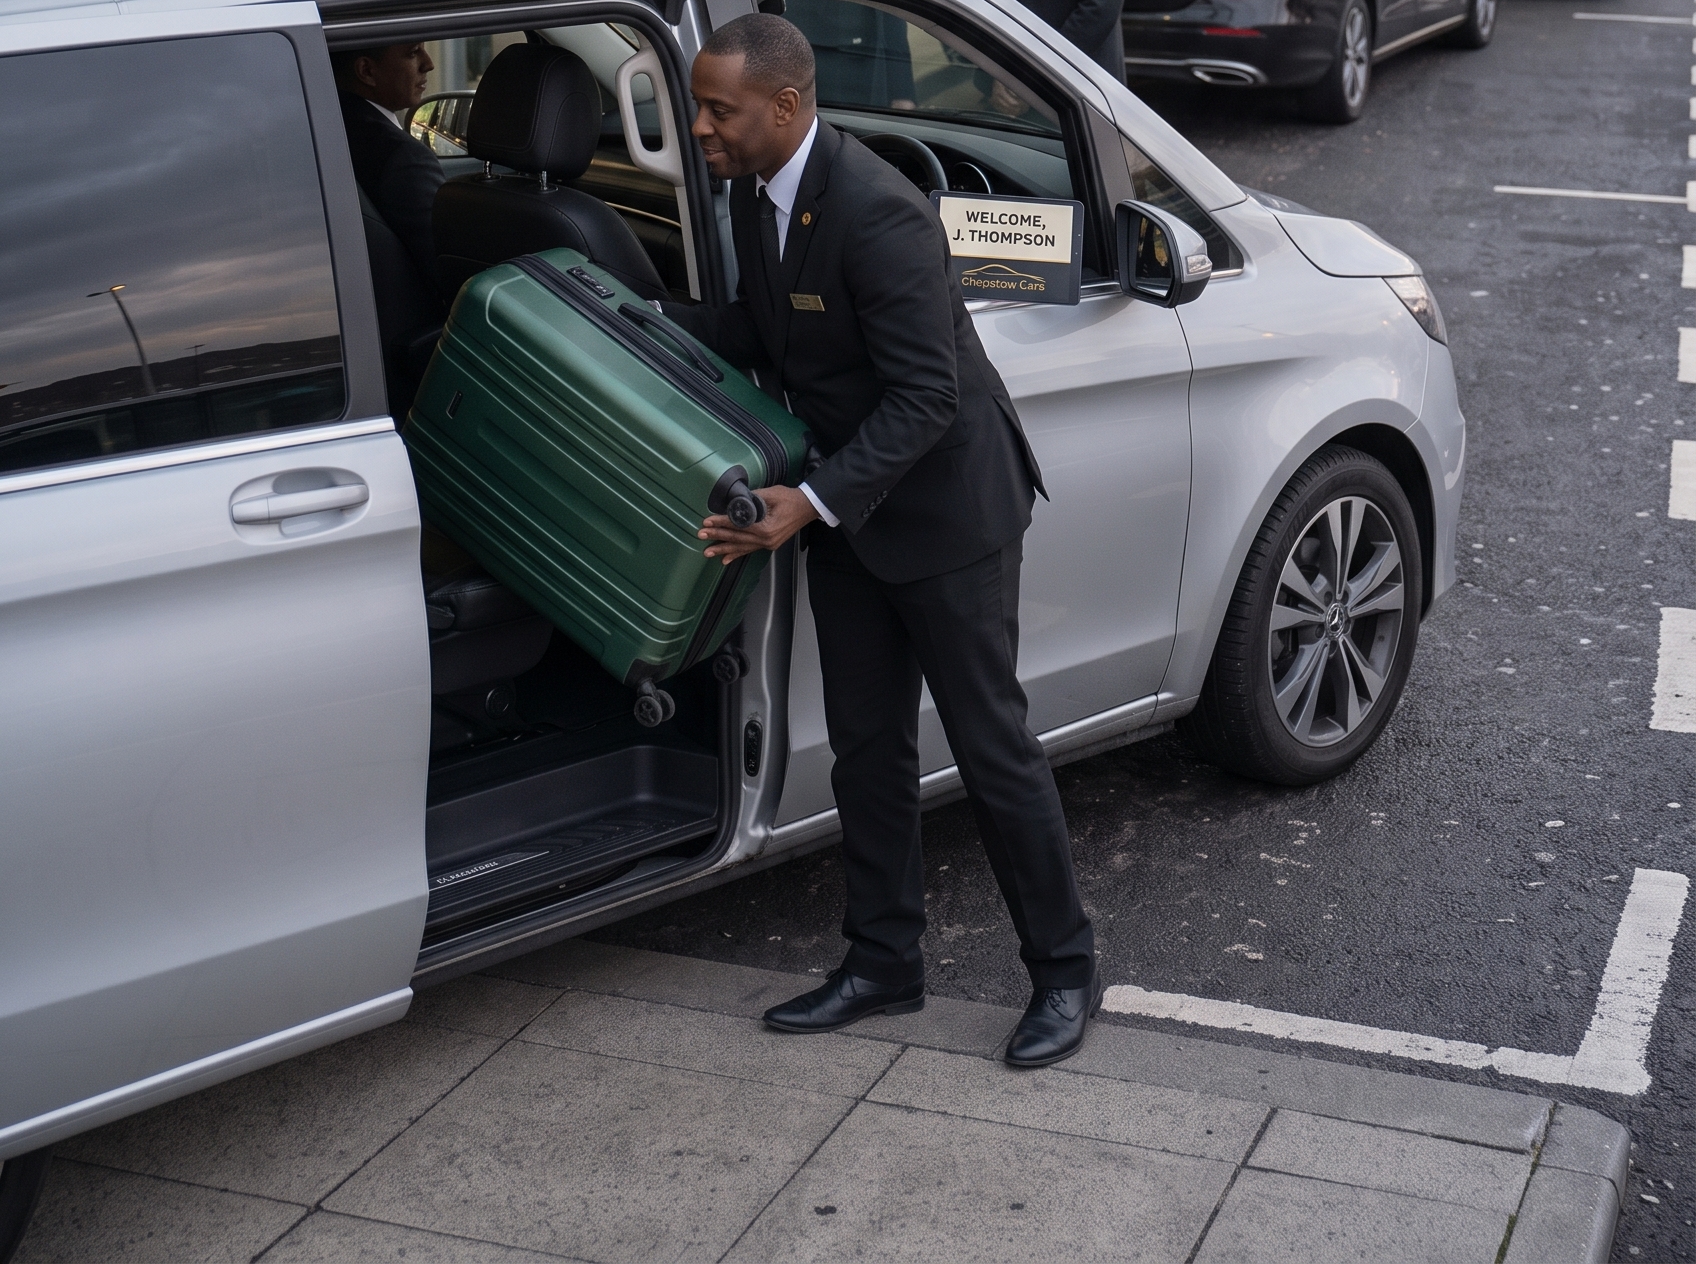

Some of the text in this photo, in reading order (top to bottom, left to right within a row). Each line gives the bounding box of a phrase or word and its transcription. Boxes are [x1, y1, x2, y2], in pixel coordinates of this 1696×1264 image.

[966, 210, 1046, 230] WELCOME,
[952, 228, 1055, 247] J. THOMPSON
[961, 276, 1046, 292] Chepstow Cars
